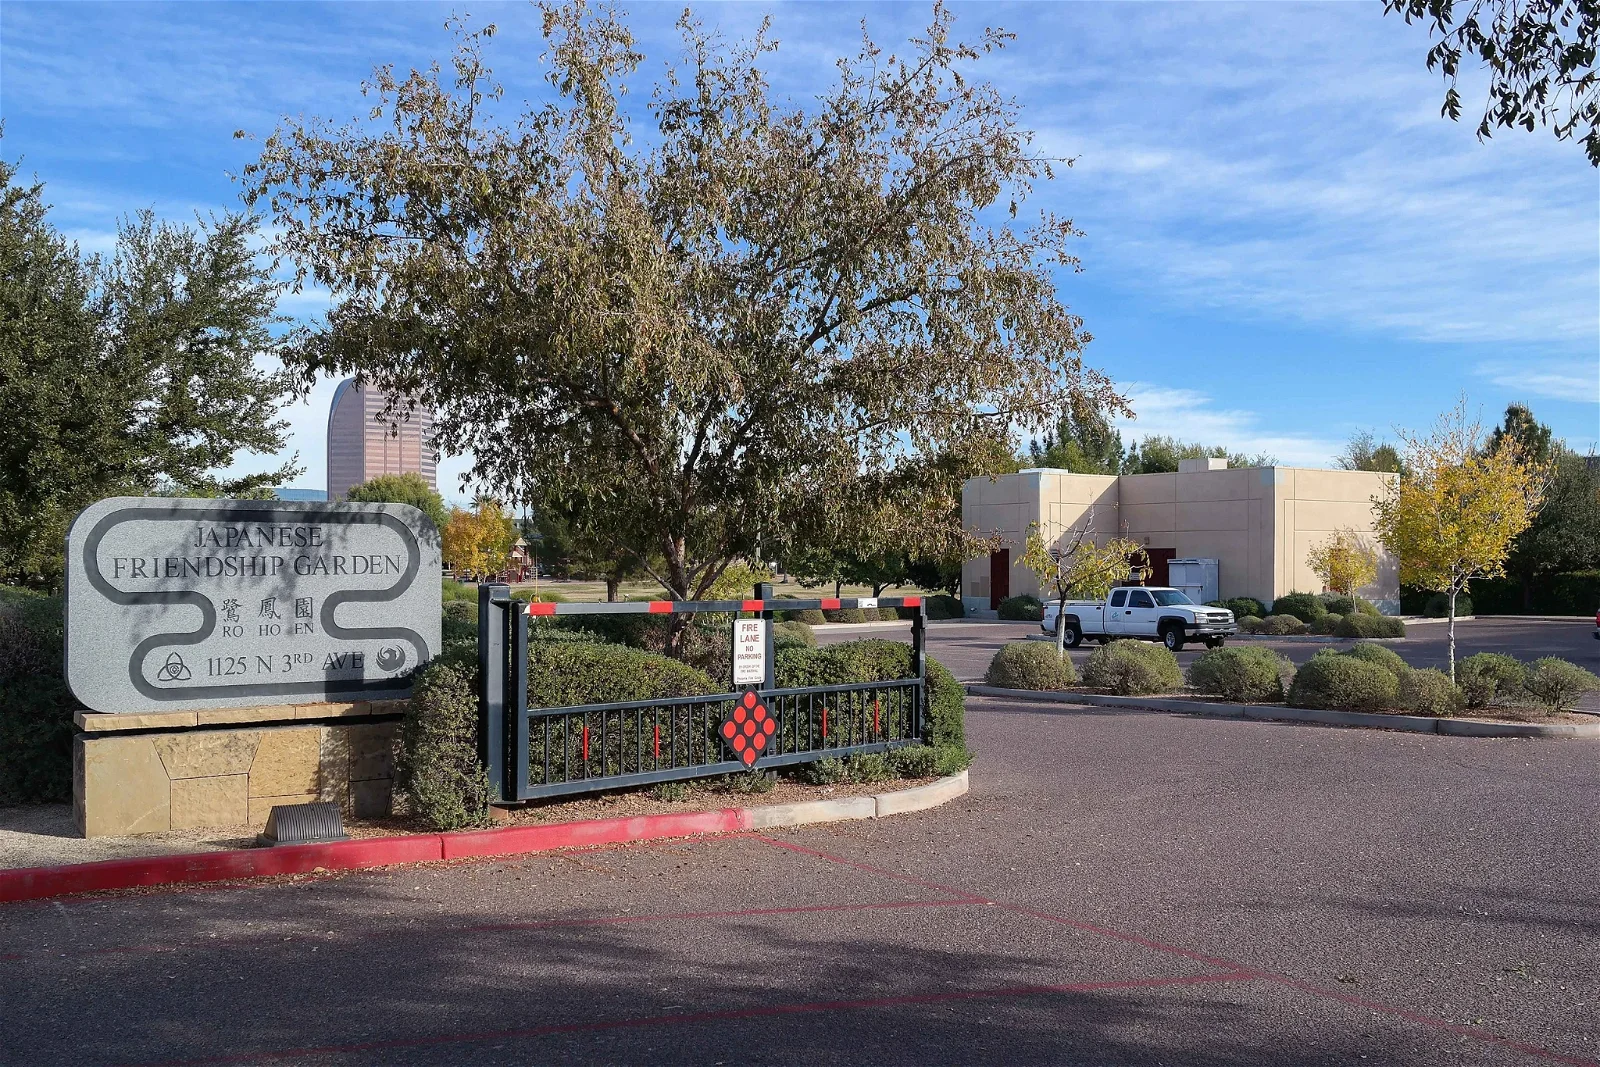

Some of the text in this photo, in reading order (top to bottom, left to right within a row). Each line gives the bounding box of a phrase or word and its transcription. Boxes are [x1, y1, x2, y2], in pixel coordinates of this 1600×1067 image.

[194, 526, 324, 548] JAPANESE
[113, 554, 401, 579] FRIENDSHIP GARDEN
[223, 622, 314, 638] RO HO EN
[742, 624, 758, 632] FIRE
[740, 634, 760, 642] LANE
[207, 651, 365, 676] 1125 N 3RD AVE
